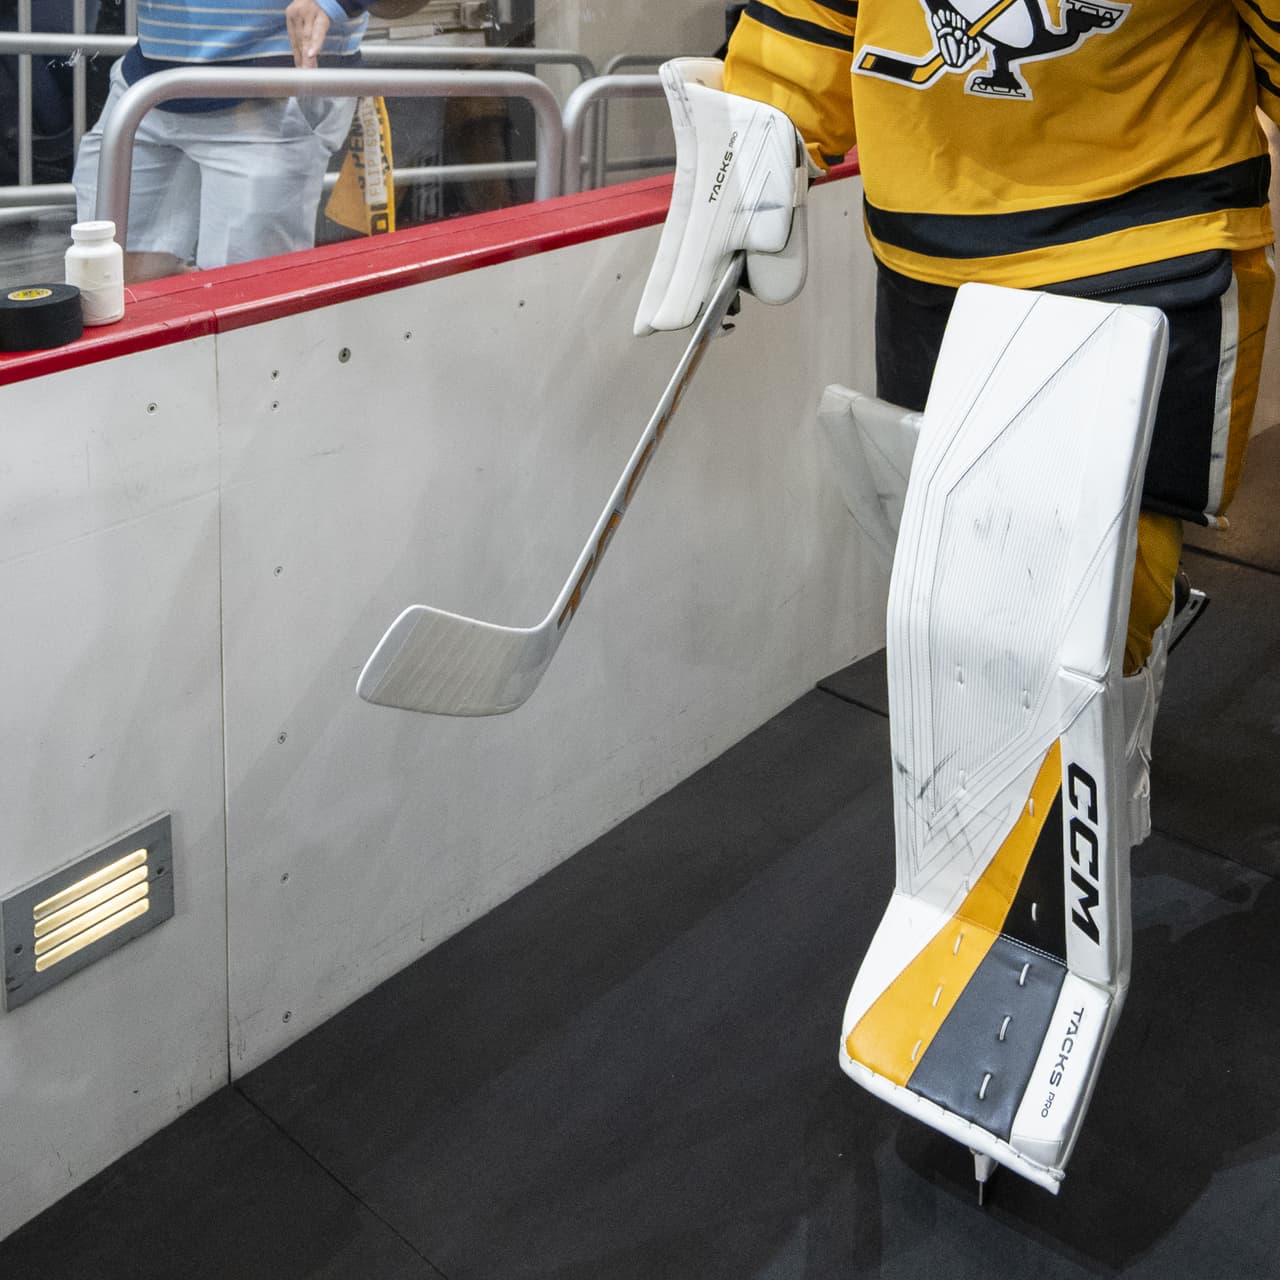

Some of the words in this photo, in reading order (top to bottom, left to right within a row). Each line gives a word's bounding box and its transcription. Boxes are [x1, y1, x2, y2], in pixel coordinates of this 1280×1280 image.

[708, 150, 734, 204] TACKS
[1067, 761, 1102, 947] CCM
[1048, 1006, 1086, 1088] TACKS
[1041, 1091, 1056, 1119] PRO
